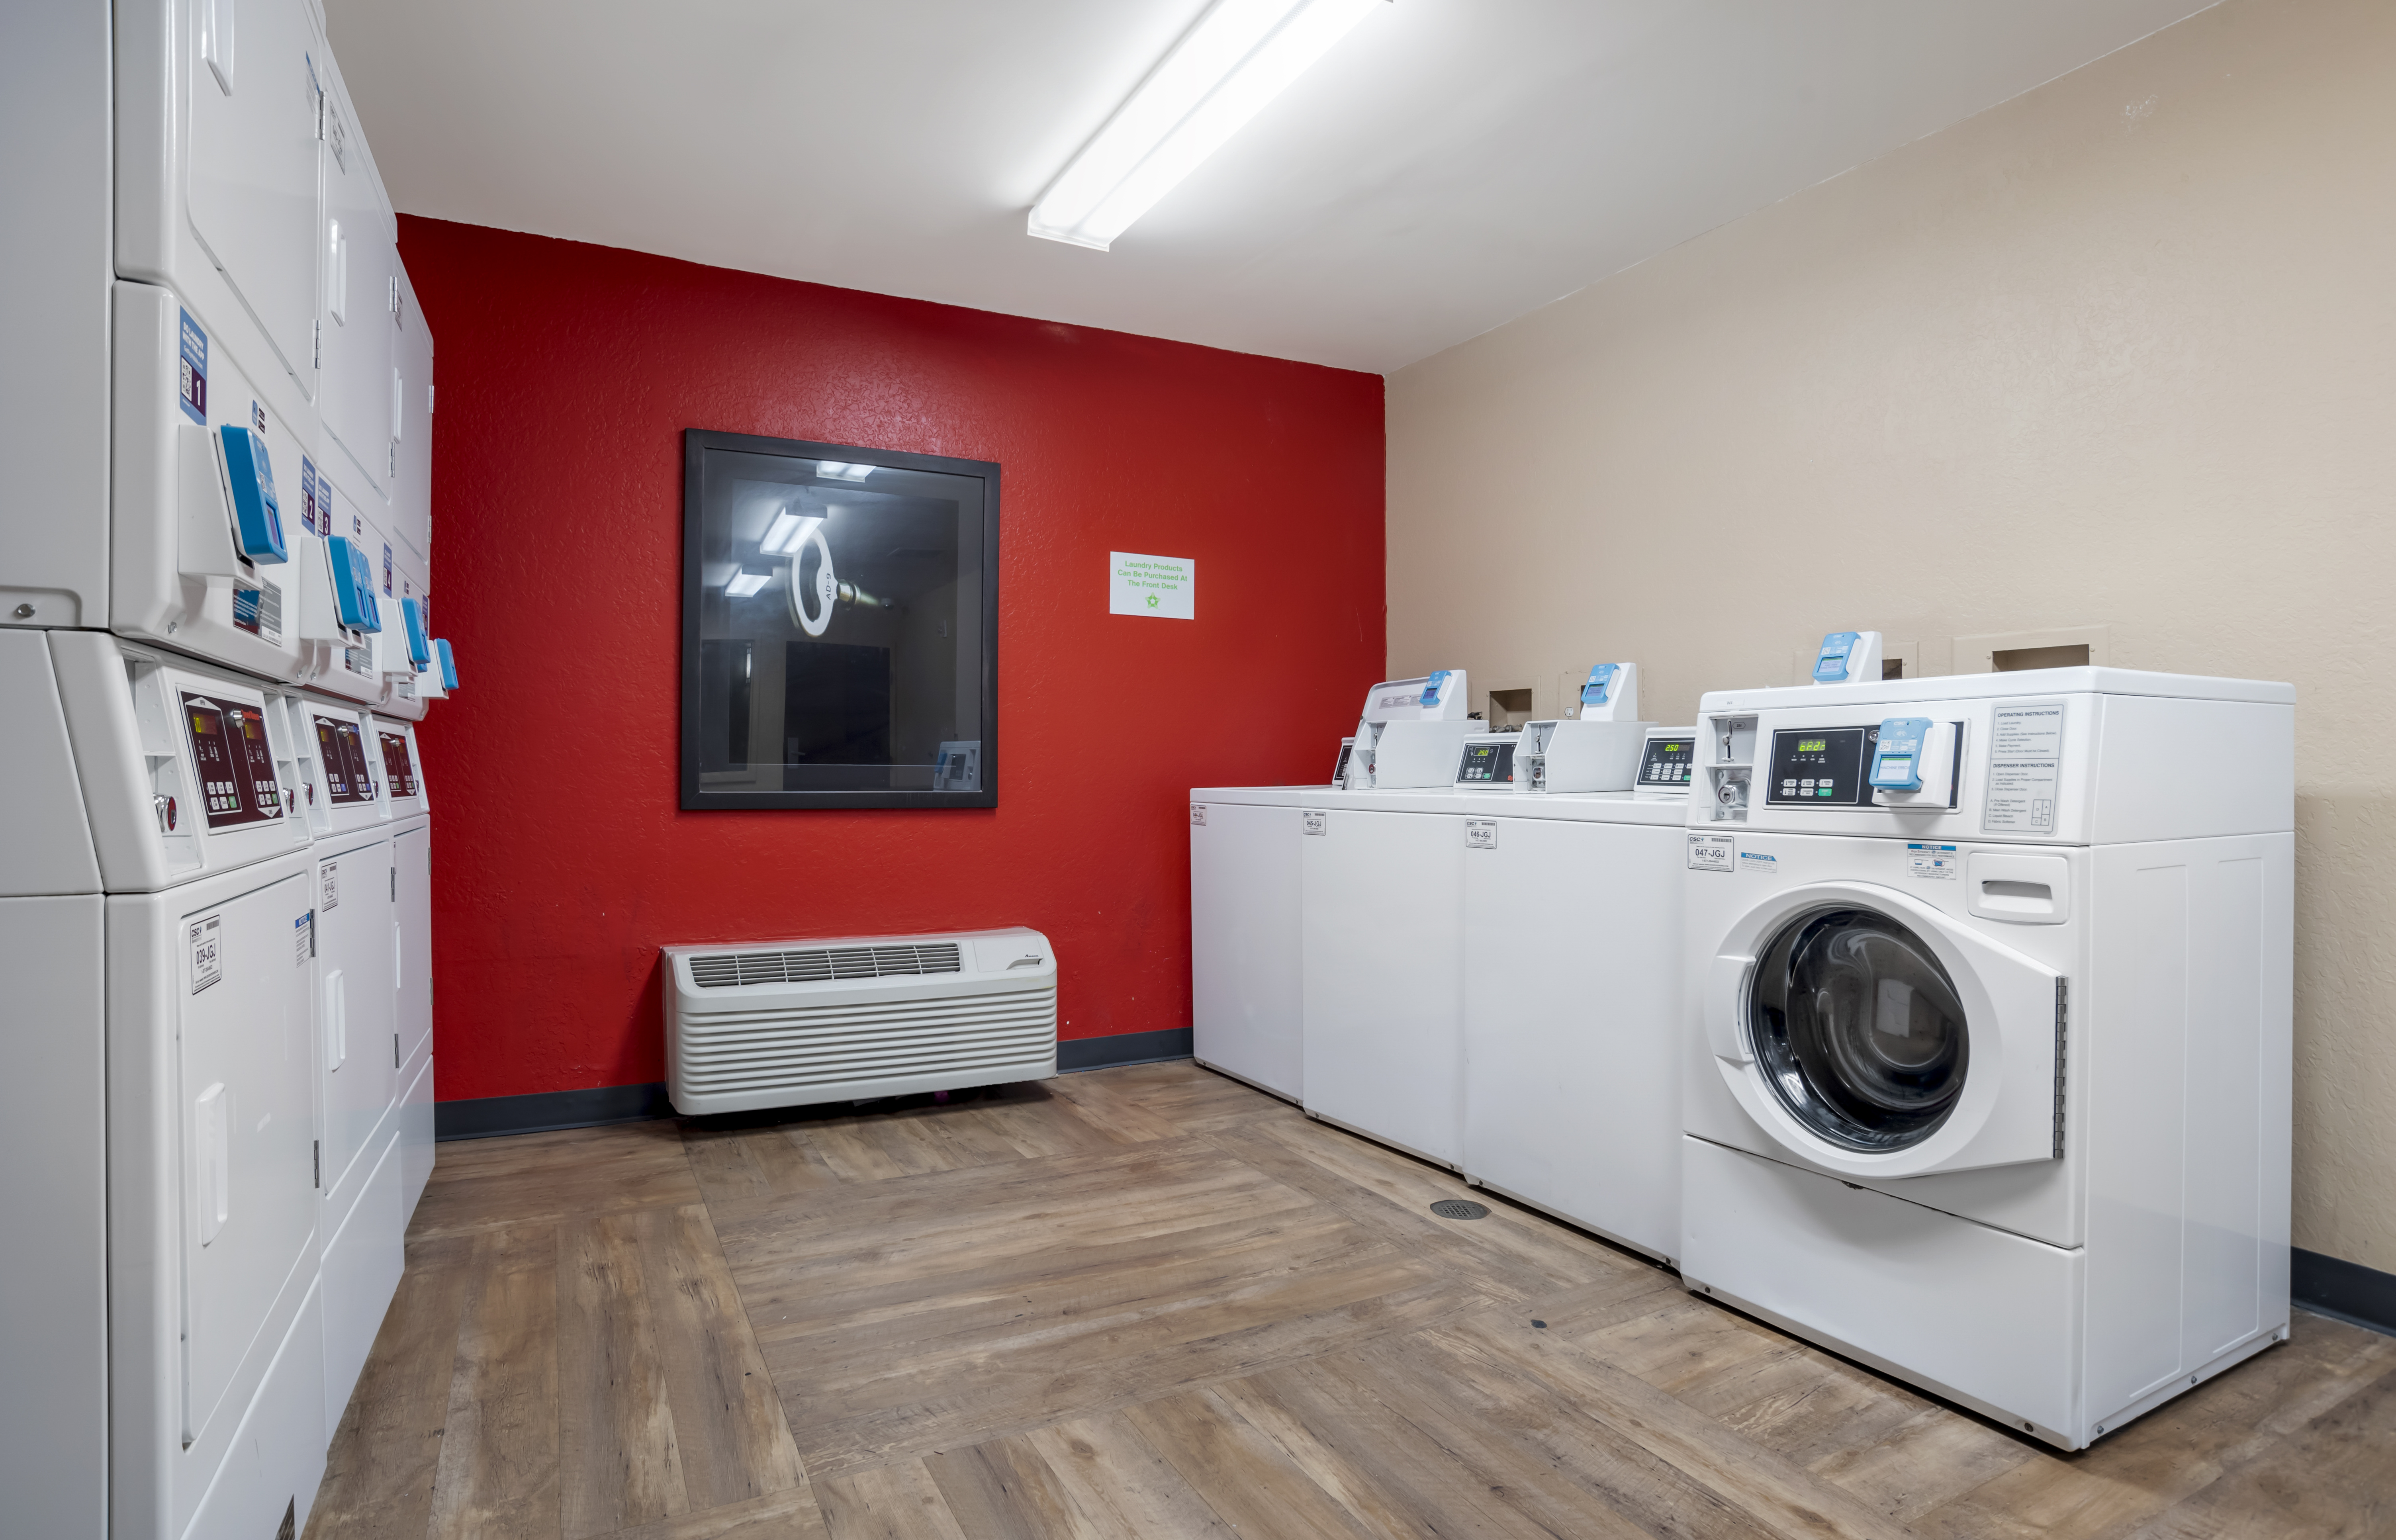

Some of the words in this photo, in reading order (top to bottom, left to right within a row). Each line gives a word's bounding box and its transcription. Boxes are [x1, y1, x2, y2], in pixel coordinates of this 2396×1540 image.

[182, 331, 191, 347] WITH
[184, 321, 189, 333] DO
[189, 328, 204, 350] LAUNDRY
[196, 380, 201, 406] 1
[309, 500, 313, 519] 2
[325, 517, 328, 534] 3
[1125, 561, 1151, 570] Laundry
[1154, 564, 1182, 572] Products
[388, 574, 390, 587] 4
[1144, 572, 1178, 581] Purchased
[1695, 849, 1725, 857] 047-JGJ
[196, 943, 215, 965] 039-JGJ
